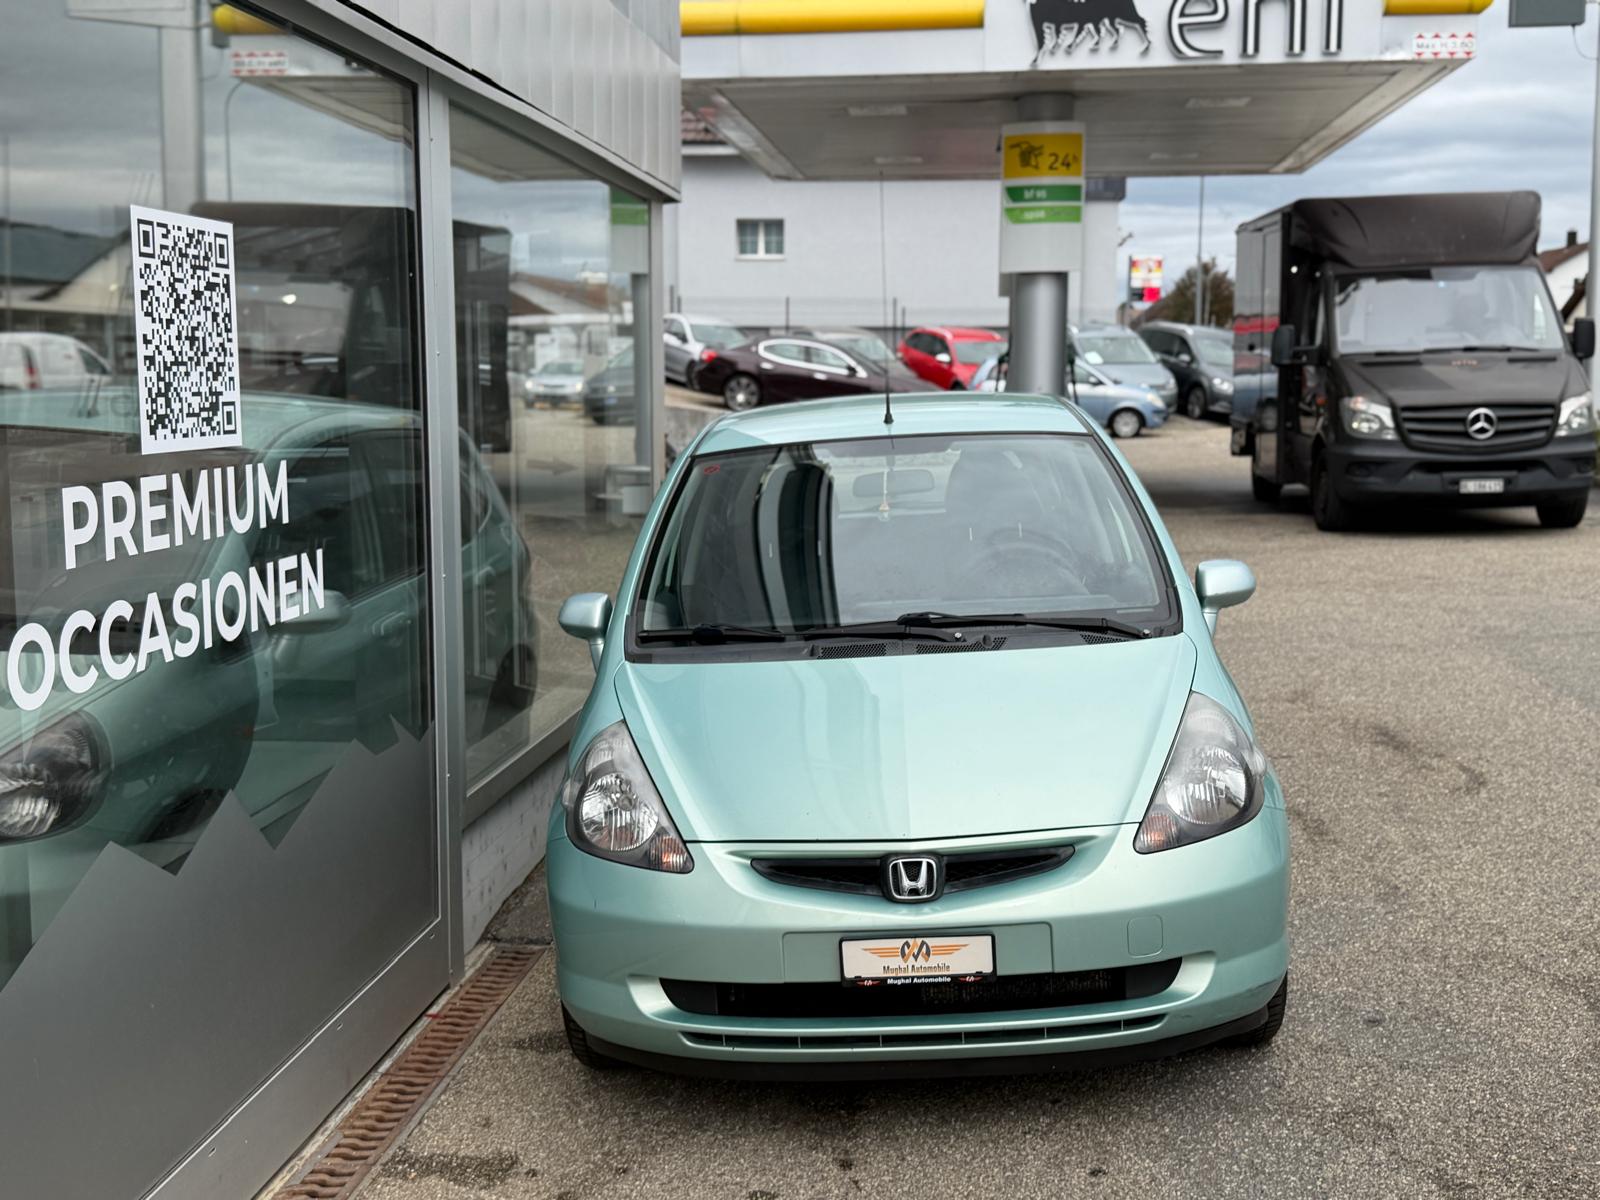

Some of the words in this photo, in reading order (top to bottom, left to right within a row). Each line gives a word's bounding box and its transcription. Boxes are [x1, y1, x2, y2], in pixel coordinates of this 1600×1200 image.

[62, 459, 290, 570] PREMIUM
[7, 549, 326, 711] OCCASIONEN
[882, 964, 910, 976] Mughal
[911, 962, 951, 974] Automobile
[887, 977, 912, 986] Mughal
[913, 975, 952, 984] Automobile
